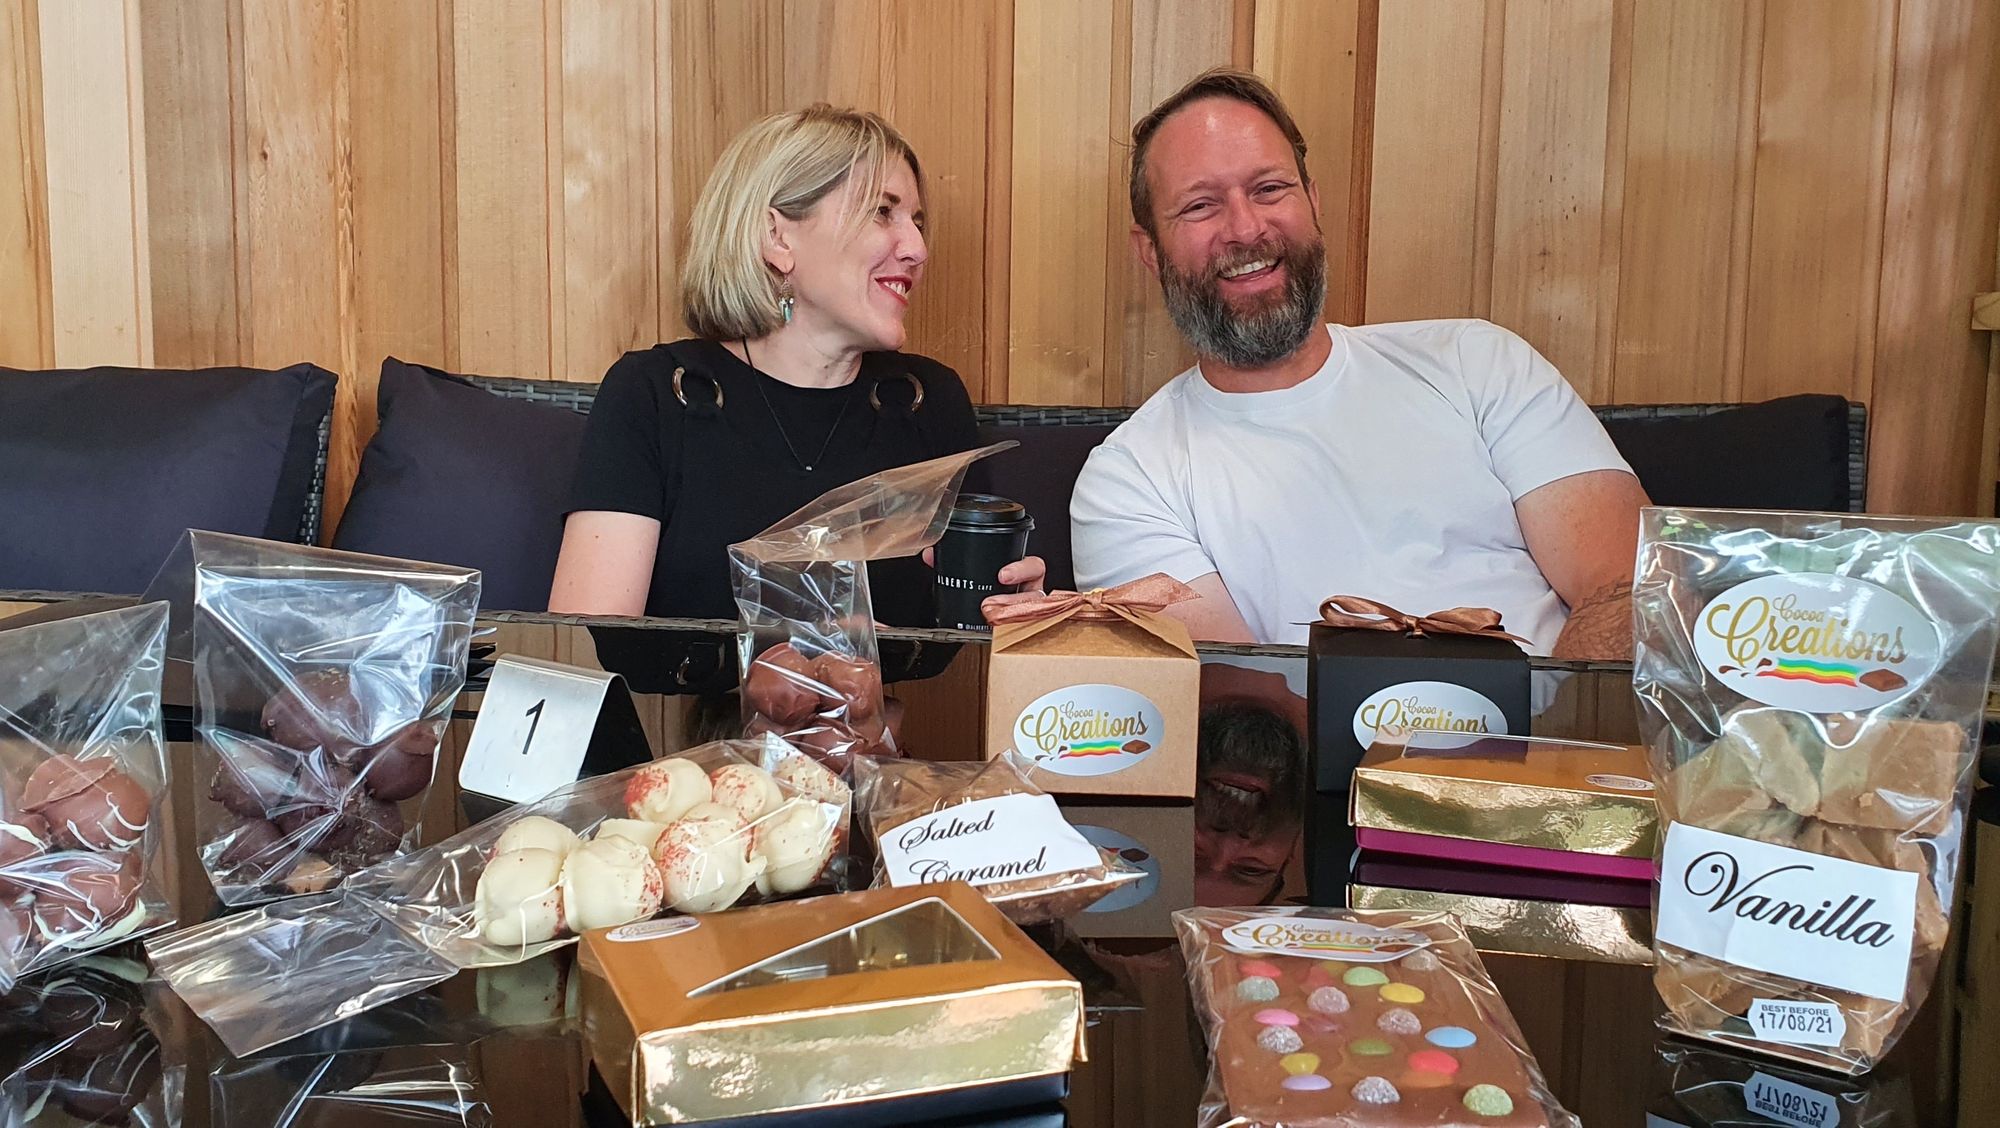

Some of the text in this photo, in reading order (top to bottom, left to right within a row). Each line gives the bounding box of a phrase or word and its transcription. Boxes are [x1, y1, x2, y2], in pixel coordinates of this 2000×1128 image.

[1773, 594, 1824, 622] Cocoa
[1706, 596, 1908, 667] Creations
[1060, 701, 1093, 719] Cocoa
[1402, 696, 1437, 715] Cocoa
[522, 698, 546, 755] 1
[1020, 706, 1149, 754] Creations
[899, 810, 995, 854] Salted
[909, 846, 1046, 884] Caramel
[1684, 851, 1895, 948] Vanilla
[1759, 1012, 1832, 1033] 17/08/21
[1761, 1004, 1829, 1016] BEST BEFORE
